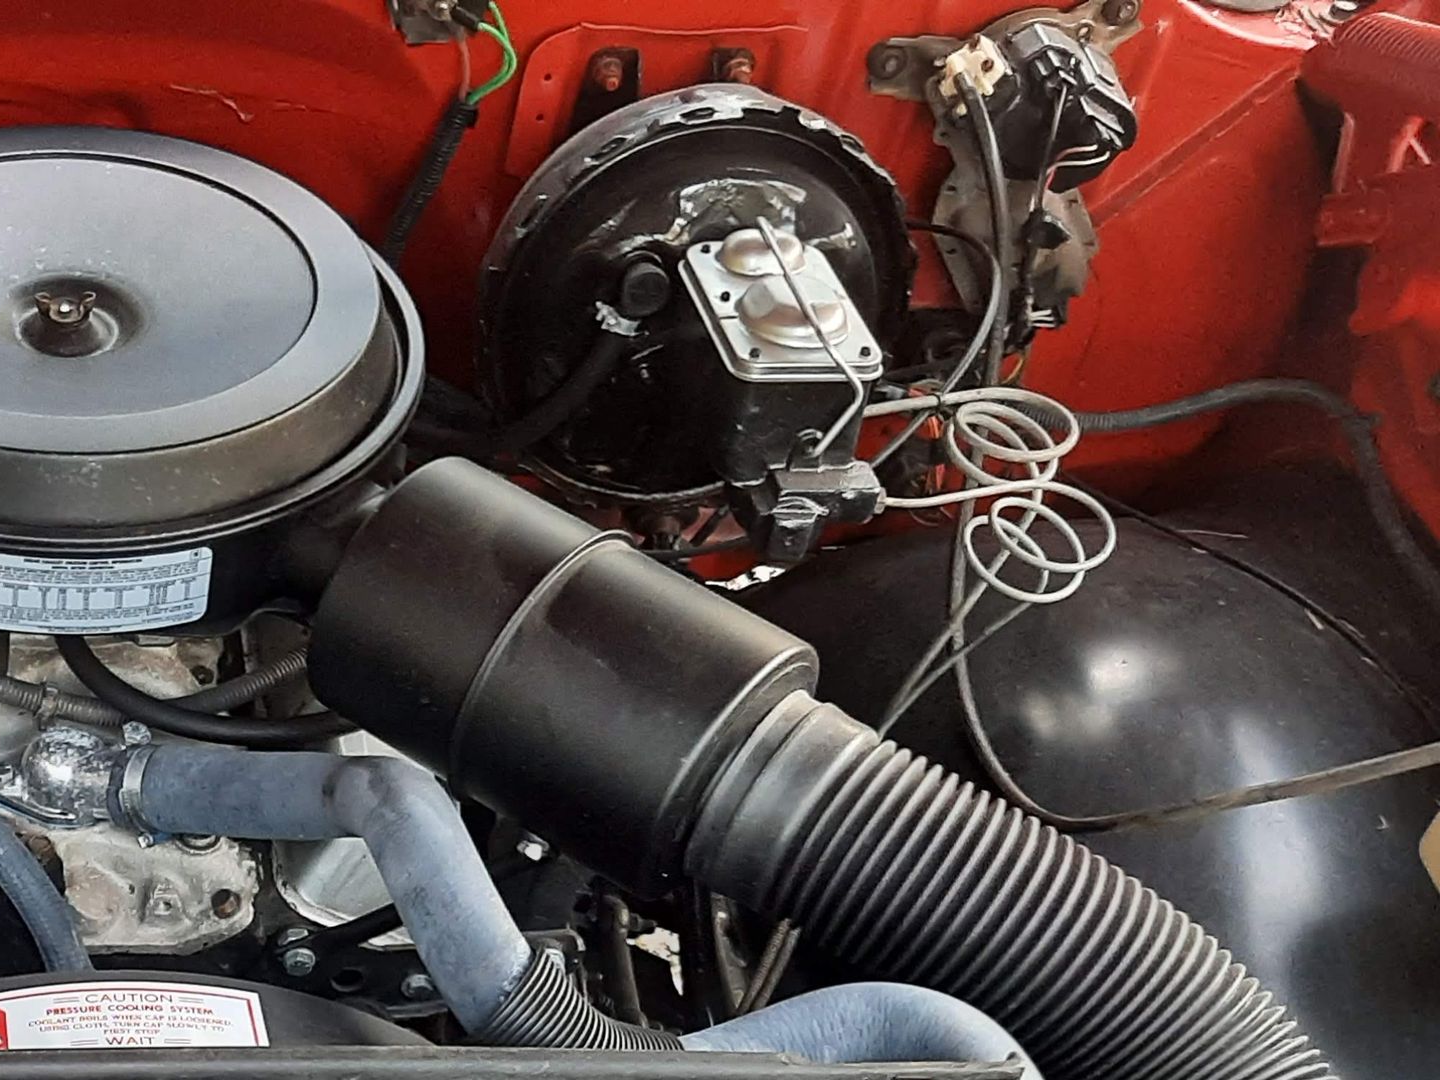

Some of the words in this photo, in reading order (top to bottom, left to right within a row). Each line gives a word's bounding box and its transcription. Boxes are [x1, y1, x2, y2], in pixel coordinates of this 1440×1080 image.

[85, 993, 173, 1003] CAUTION
[46, 1005, 102, 1016] PRESSURE
[108, 1004, 163, 1012] COOLING
[170, 1006, 213, 1015] SYSTEM
[28, 1017, 76, 1027] COOLANT
[166, 1022, 207, 1031] SLOWLY
[106, 1036, 155, 1045] WAIT
